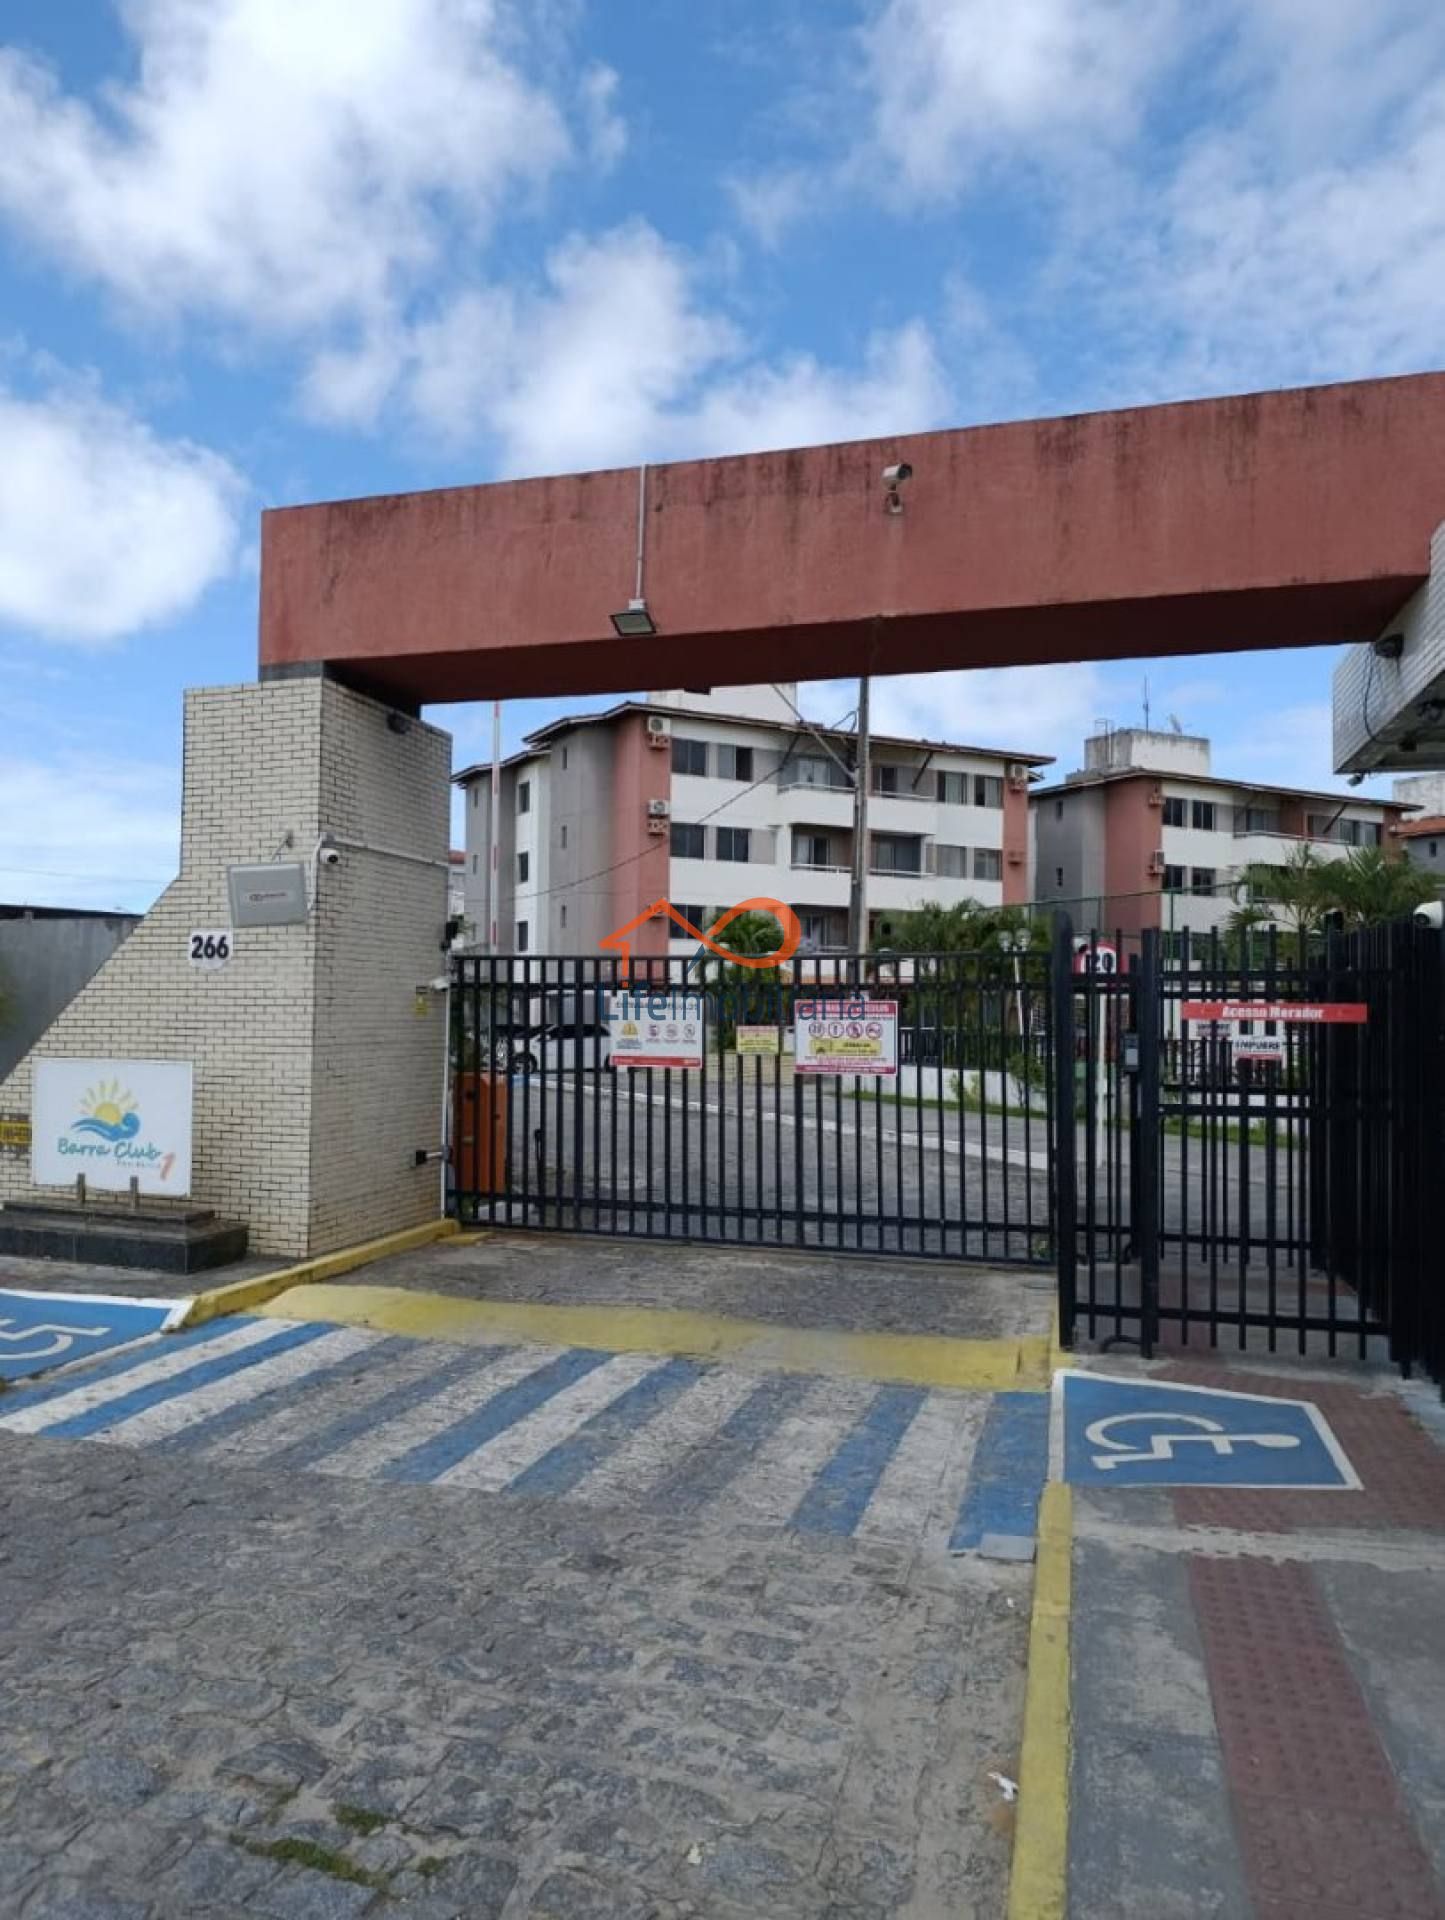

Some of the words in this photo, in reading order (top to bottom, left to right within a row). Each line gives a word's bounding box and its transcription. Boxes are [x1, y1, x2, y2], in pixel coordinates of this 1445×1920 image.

[191, 934, 229, 959] 266
[1269, 1005, 1325, 1019] Morador
[57, 1137, 111, 1155] Barra
[114, 1142, 162, 1160] Club
[159, 1151, 176, 1181] 1
